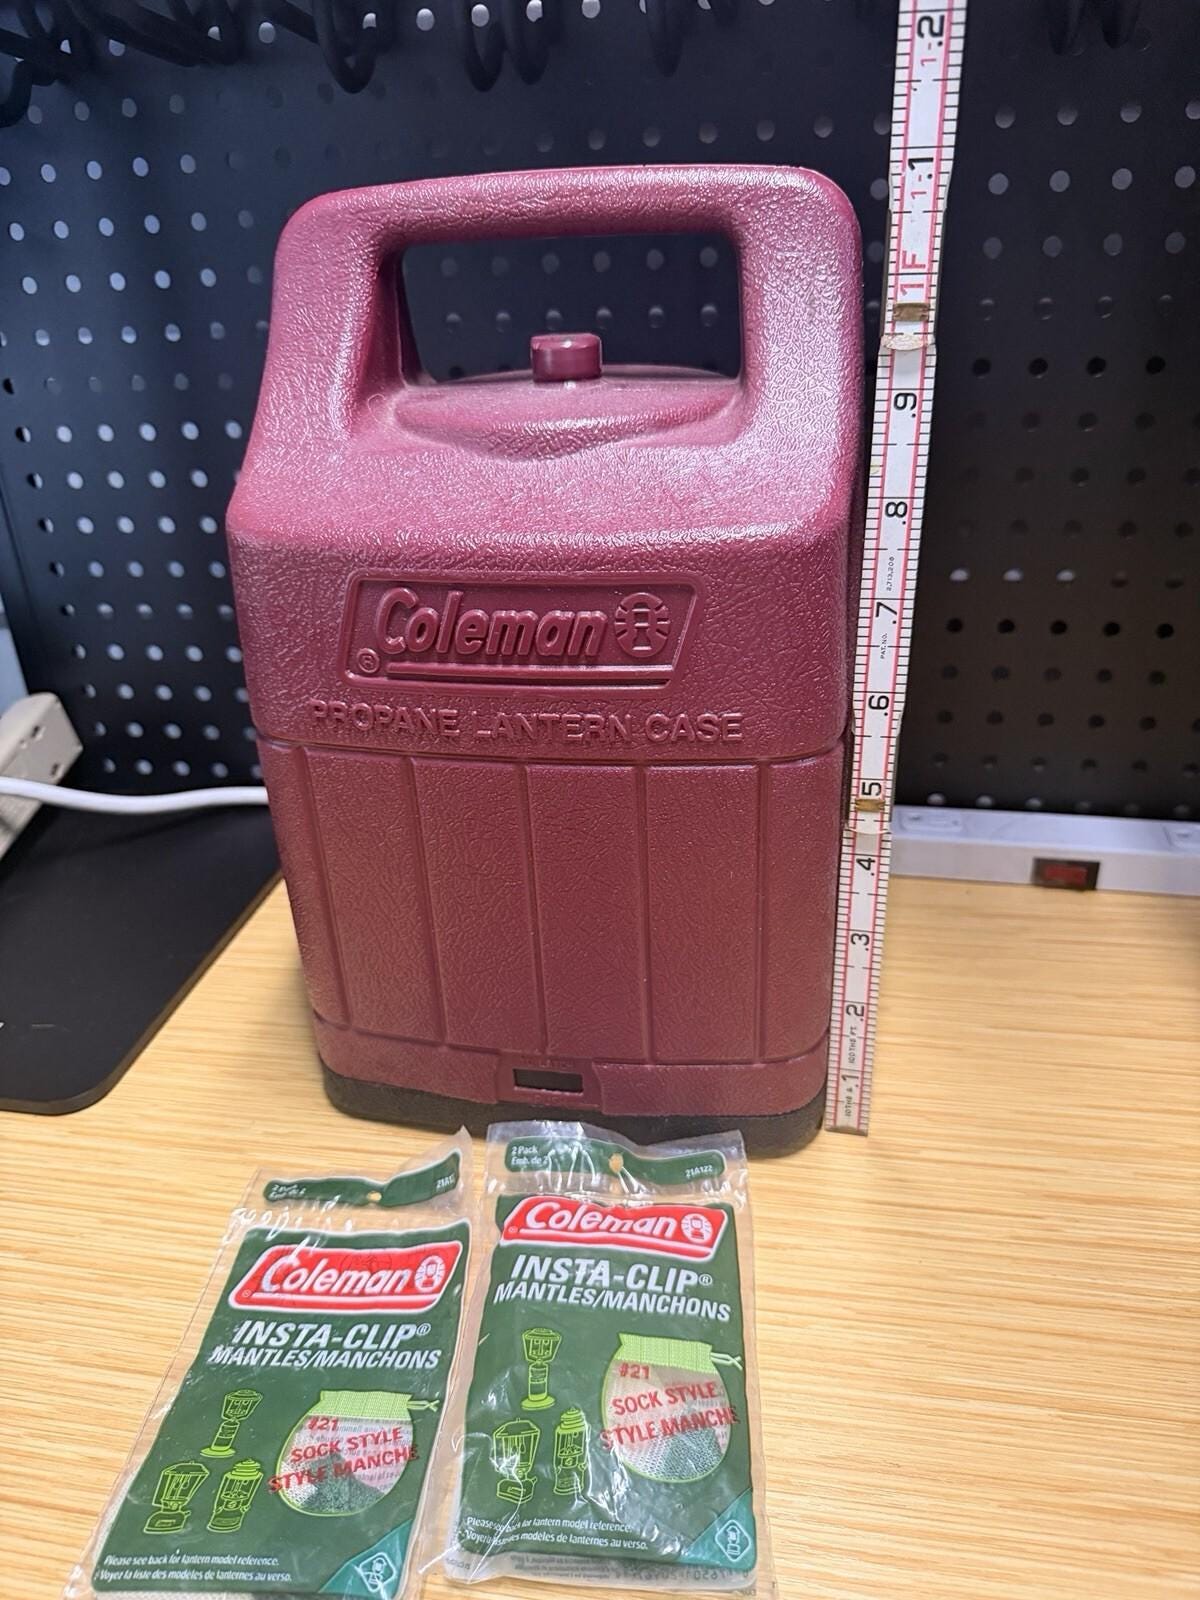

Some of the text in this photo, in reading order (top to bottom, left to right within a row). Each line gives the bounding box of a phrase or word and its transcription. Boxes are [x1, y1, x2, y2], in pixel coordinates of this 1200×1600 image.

[375, 587, 608, 657] Coleman
[309, 699, 744, 743] PROPANE LANTERN CASE
[518, 1146, 538, 1155] Pack
[526, 1201, 678, 1239] Coleman
[262, 1254, 411, 1294] Coleman
[493, 1280, 731, 1322] MANTLES/MANCHONS
[208, 1345, 442, 1370] MANTLES/MANCHONS
[619, 1362, 650, 1380] #21
[612, 1381, 717, 1416] SOCK STYLE
[290, 1426, 402, 1463] SOCK STYLE
[600, 1406, 740, 1450] STYLE MANCHE
[268, 1464, 326, 1494] STYLE
[333, 1443, 419, 1478] MANCHE
[533, 1517, 561, 1528] lantern
[562, 1518, 588, 1530] model
[556, 1533, 568, 1543] de
[569, 1533, 609, 1547] lanternes
[610, 1538, 621, 1548] au
[104, 1555, 131, 1565] Please
[132, 1557, 148, 1565] see
[148, 1555, 168, 1564] back
[168, 1554, 180, 1564] for
[181, 1554, 210, 1565] lantern
[211, 1555, 237, 1565] model
[123, 1570, 132, 1579] la
[133, 1570, 151, 1580] liste
[152, 1570, 167, 1579] des
[204, 1569, 215, 1580] de
[216, 1570, 253, 1581] lanternes
[254, 1572, 266, 1581] au
